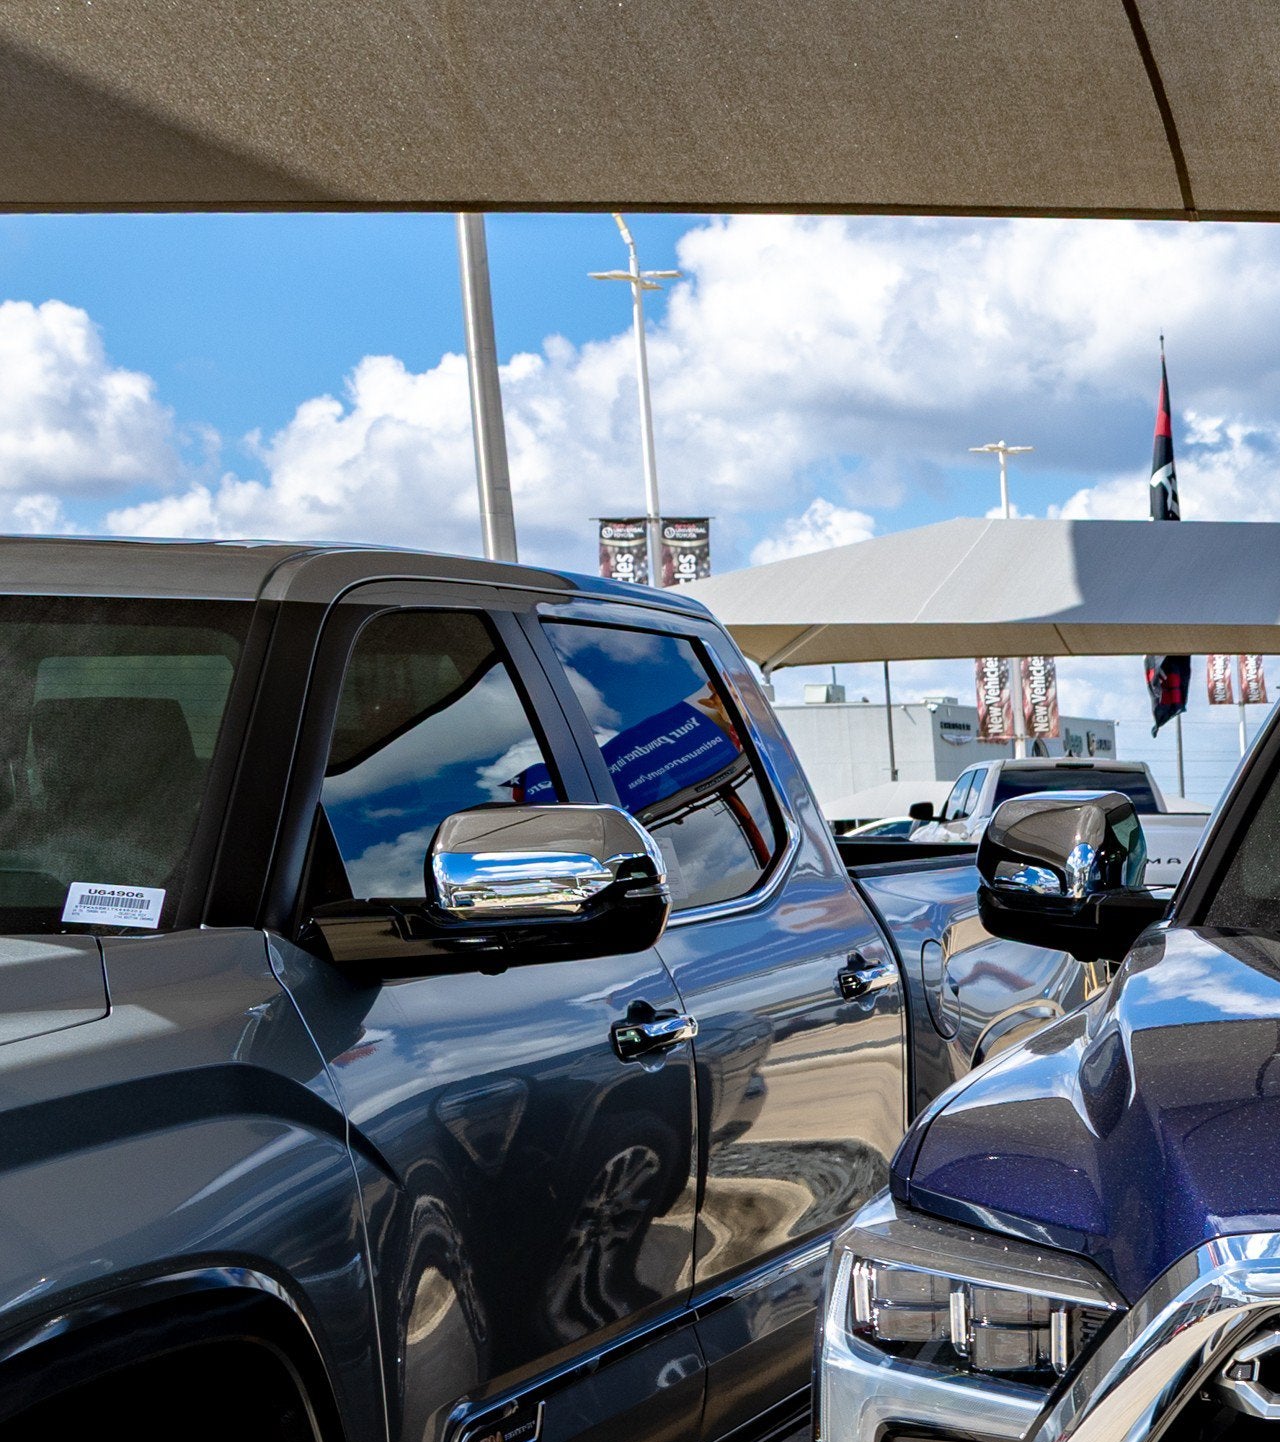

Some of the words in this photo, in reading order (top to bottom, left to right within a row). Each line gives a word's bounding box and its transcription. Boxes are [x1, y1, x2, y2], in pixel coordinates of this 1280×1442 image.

[983, 656, 1001, 705] Vehicle
[1029, 655, 1046, 704] Vehicle
[988, 706, 1004, 734] New
[1033, 705, 1049, 732] New
[88, 888, 145, 898] U64906
